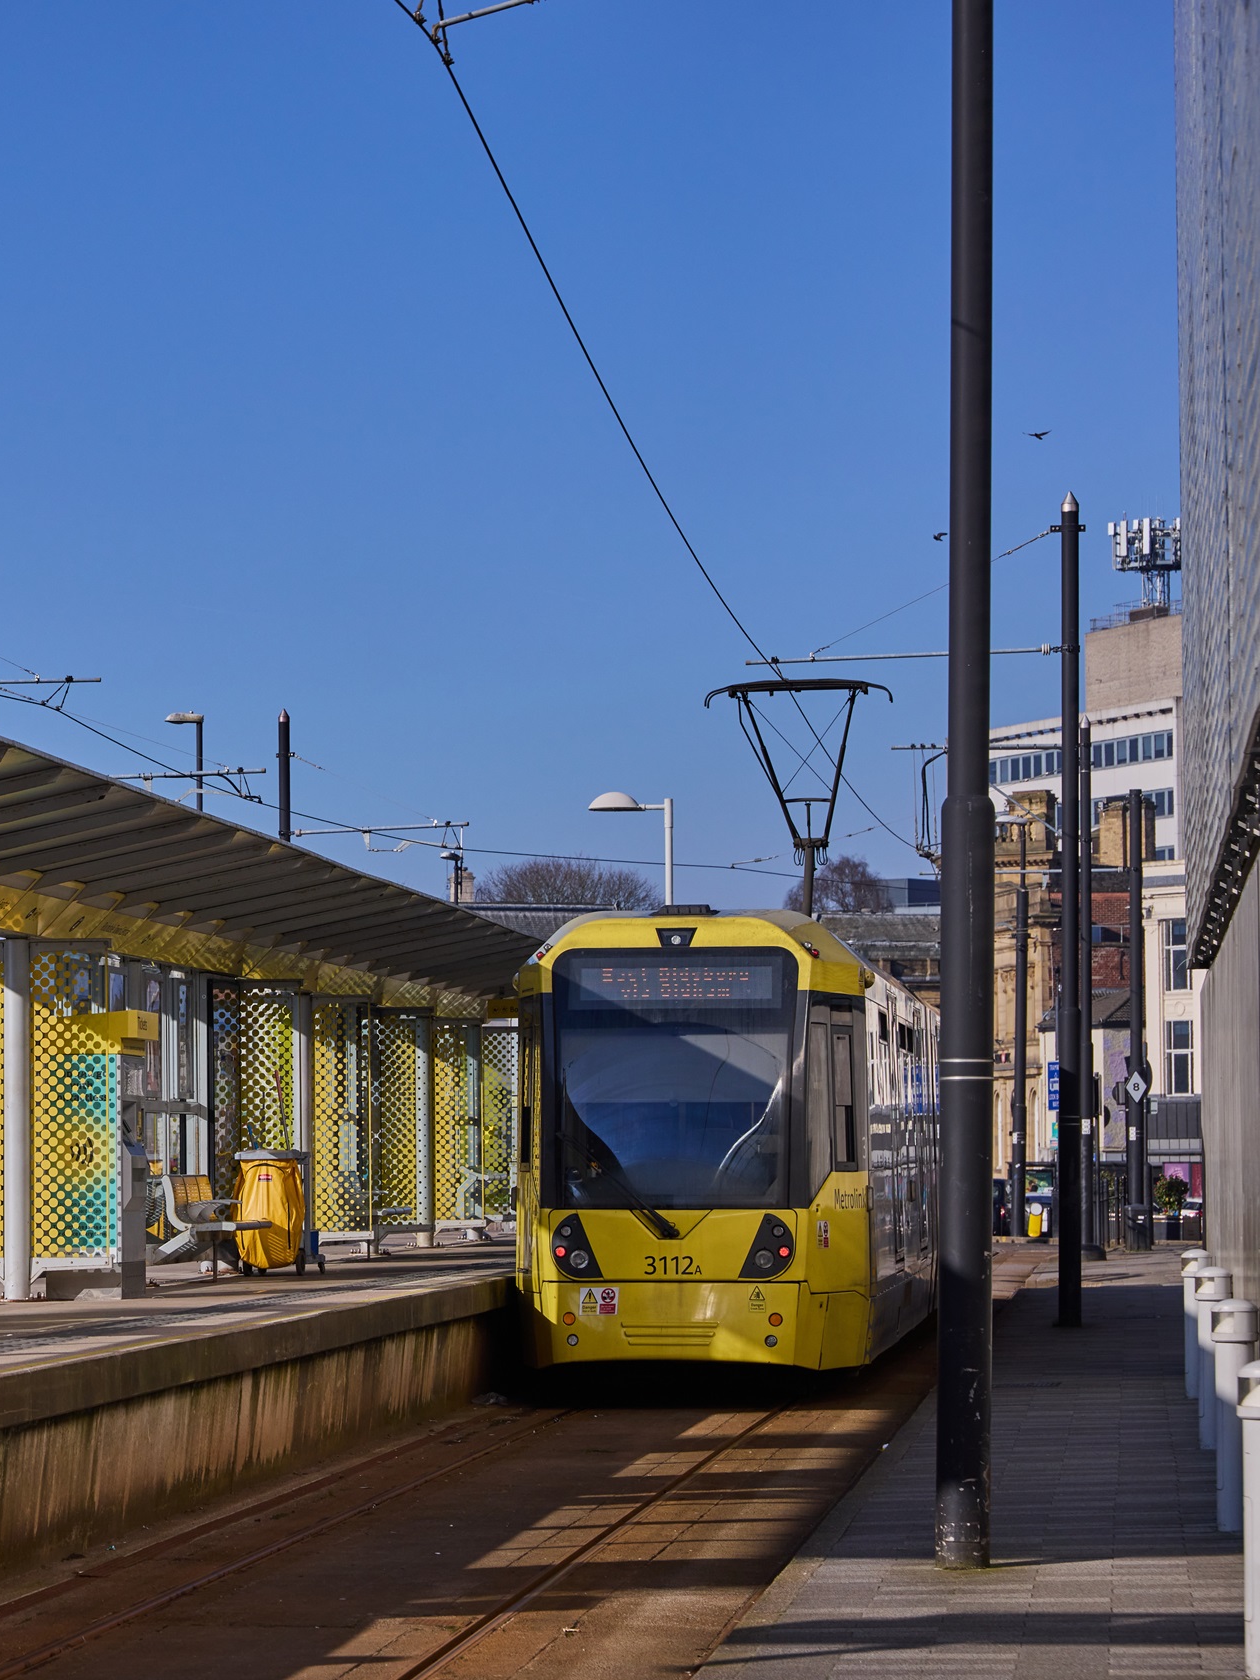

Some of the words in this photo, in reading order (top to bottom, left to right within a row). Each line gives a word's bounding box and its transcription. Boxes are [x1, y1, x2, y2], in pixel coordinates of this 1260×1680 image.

[1133, 1083, 1140, 1091] 8
[834, 1188, 867, 1210] Metrolink
[644, 1255, 702, 1275] 3112A
